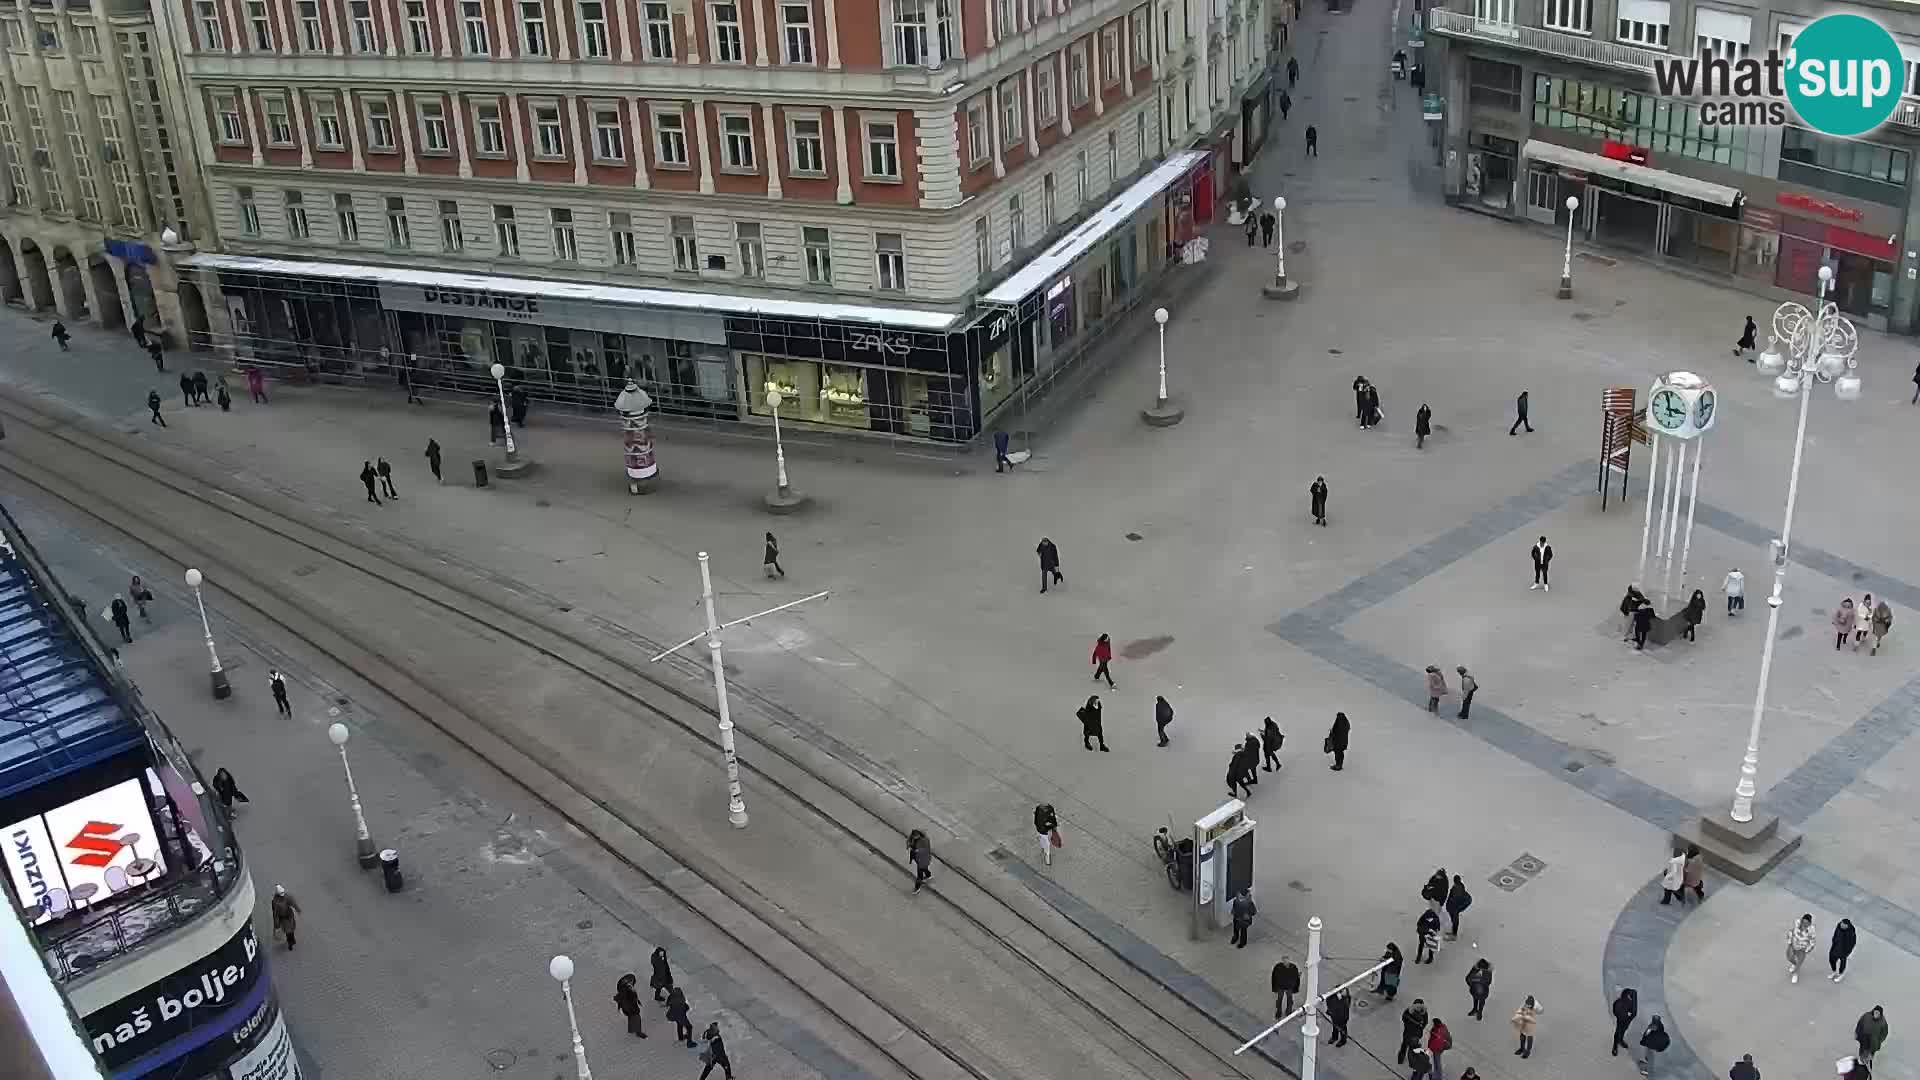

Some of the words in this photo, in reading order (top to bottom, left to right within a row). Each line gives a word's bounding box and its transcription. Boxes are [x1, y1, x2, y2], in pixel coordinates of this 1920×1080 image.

[12, 829, 53, 912] SUZUKI
[92, 1006, 152, 1055] naš
[157, 965, 245, 1021] bolje,
